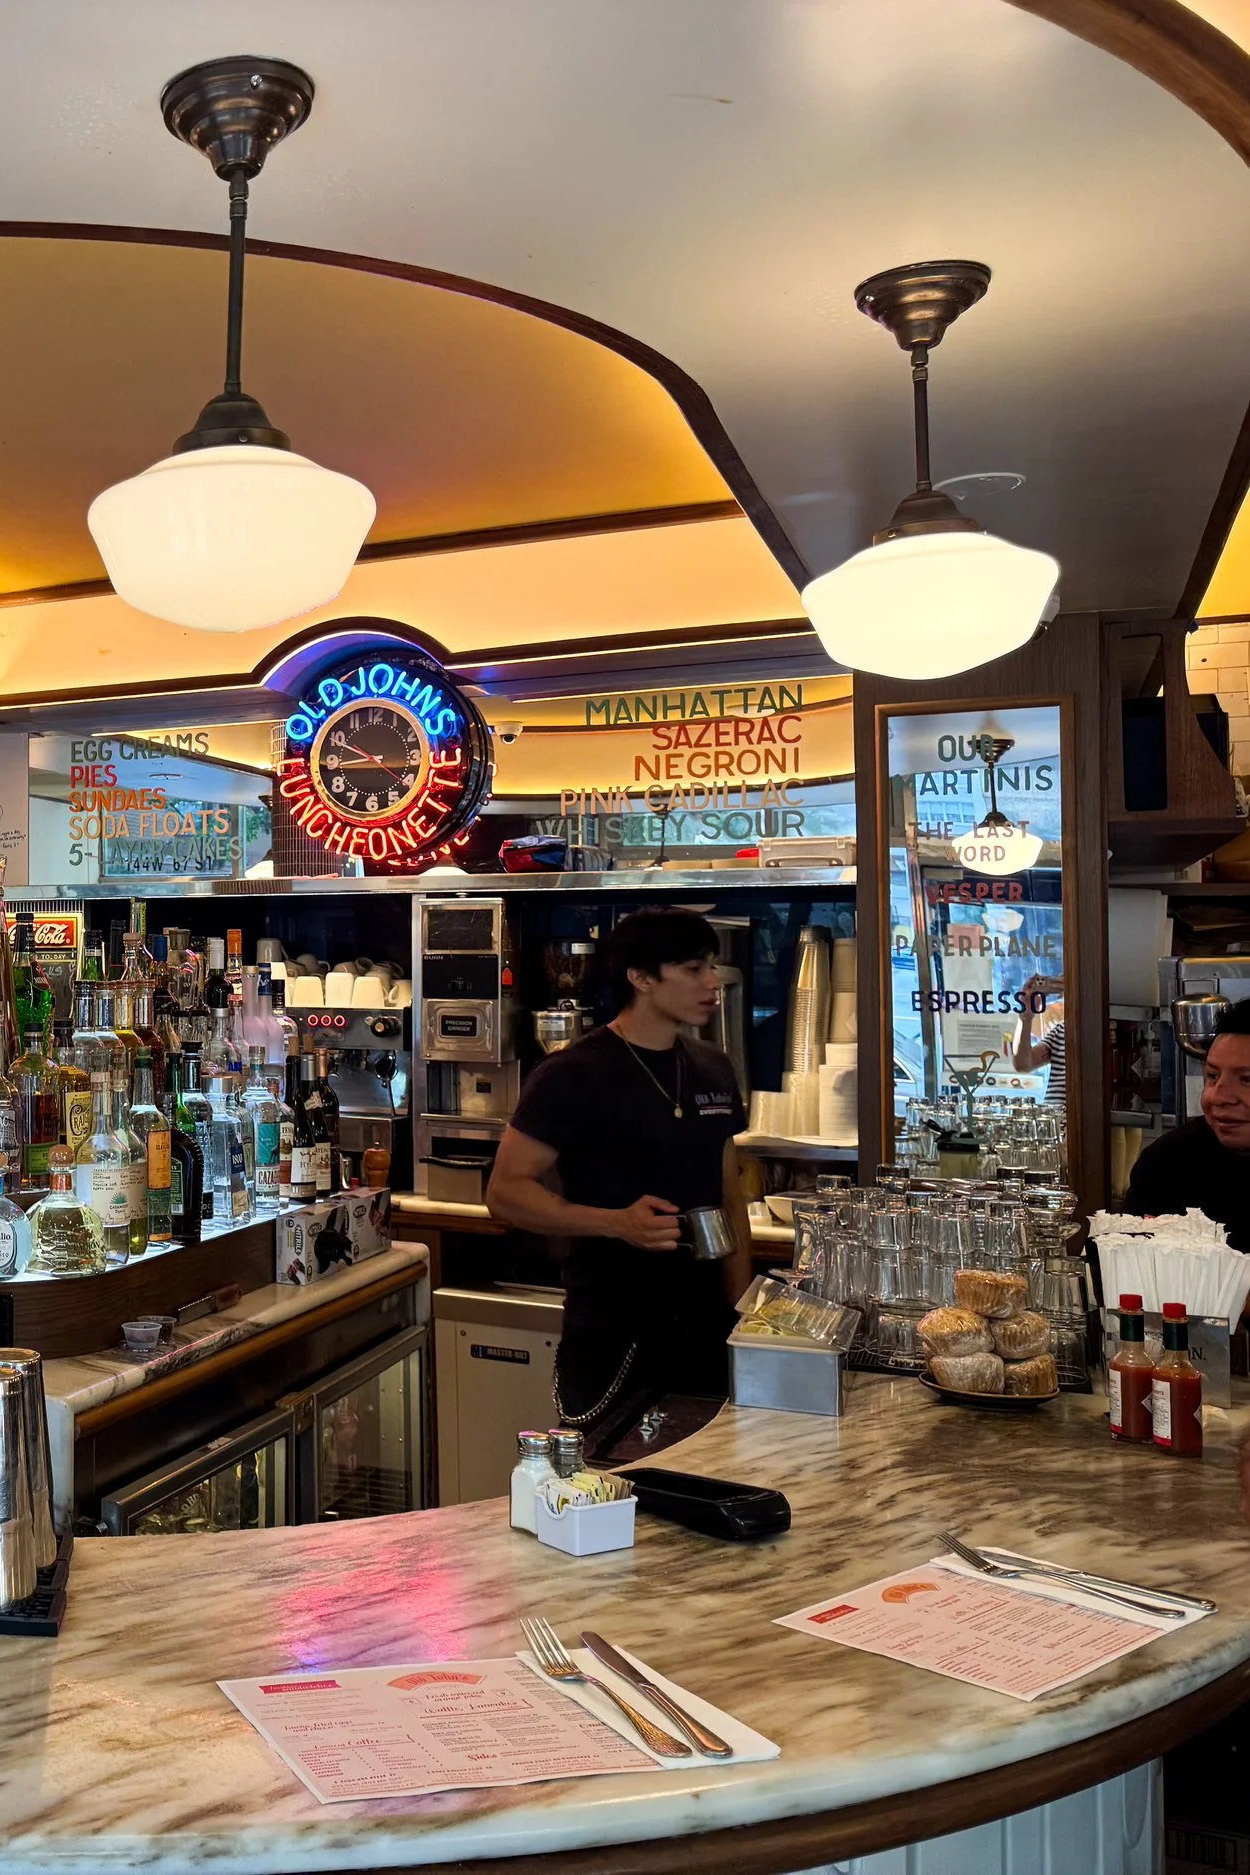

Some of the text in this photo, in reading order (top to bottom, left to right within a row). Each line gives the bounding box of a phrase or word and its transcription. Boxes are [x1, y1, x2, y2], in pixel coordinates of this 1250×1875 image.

[285, 662, 456, 741] OLD JOHNS
[585, 684, 803, 726] MANHATTAN
[350, 713, 360, 729] 11
[368, 708, 383, 723] 12
[329, 731, 346, 747] 10
[407, 727, 418, 743] 2
[652, 715, 803, 751] SAZERAC
[70, 732, 209, 763] EGG CREAMS
[409, 749, 421, 766] 3
[937, 734, 995, 763] OUR
[326, 755, 340, 770] 9
[634, 747, 800, 782] NEGRONI
[69, 764, 118, 789] PIES
[331, 776, 346, 793] 8
[402, 773, 415, 789] 4
[892, 764, 1053, 797] MARTINIS
[68, 787, 167, 814] SUNDAES
[277, 749, 462, 861] LUNCHEONETTE
[346, 791, 358, 806] 7
[365, 795, 379, 811] 6
[387, 791, 400, 806] 5
[560, 778, 805, 816] PINK CADILLAC
[68, 809, 230, 842] SODA FLOATS
[536, 809, 806, 847] WHISKEY SOUR
[907, 820, 1031, 841] THE LAST
[173, 836, 243, 861] CAKES
[944, 845, 1007, 864] WORD
[925, 881, 1024, 905] VESPER
[979, 933, 1057, 959] PLANE
[910, 989, 1048, 1015] ESPRESSO
[295, 1225, 303, 1257] NITRILE
